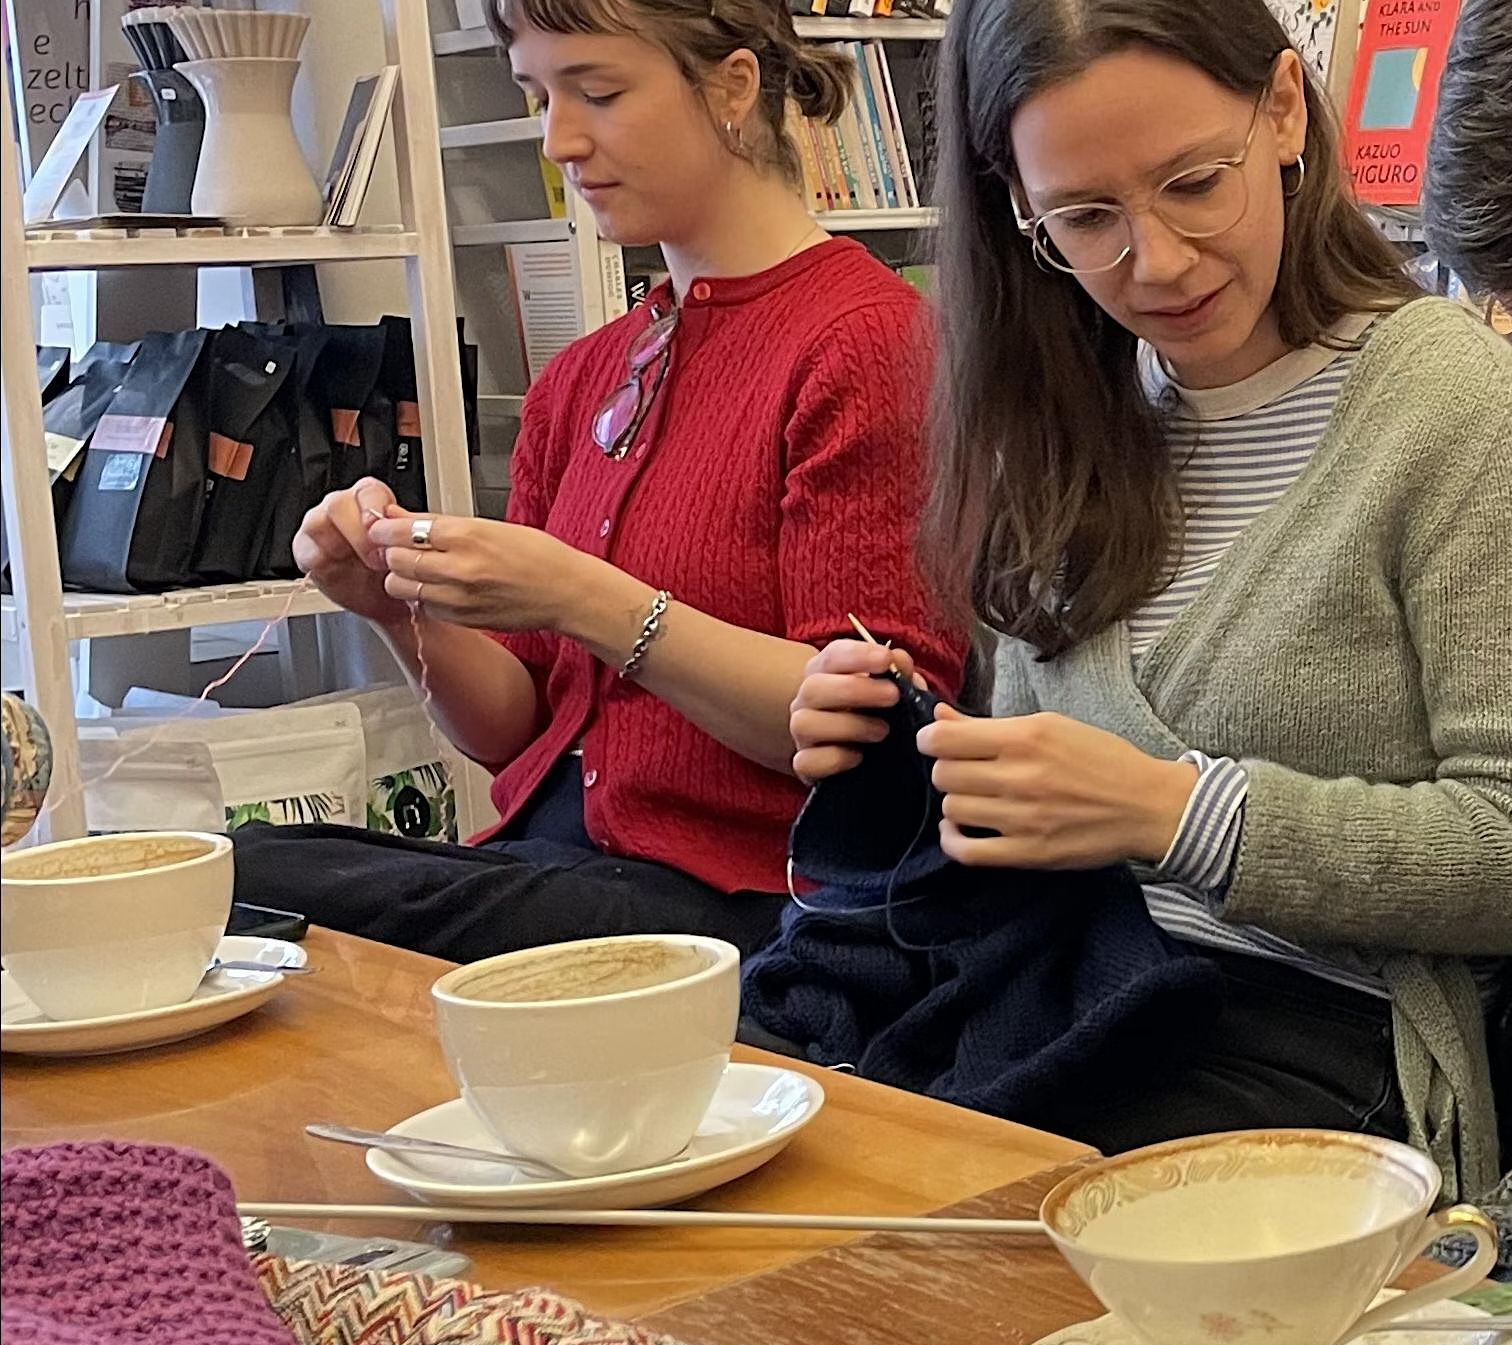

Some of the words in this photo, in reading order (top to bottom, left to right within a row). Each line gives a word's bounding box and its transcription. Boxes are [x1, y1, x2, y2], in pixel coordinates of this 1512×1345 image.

[1379, 0, 1416, 18] KLARA
[1417, 0, 1441, 13] AND
[1379, 22, 1402, 37] THE
[1405, 19, 1432, 35] SUN
[1355, 143, 1401, 161] KAZUO
